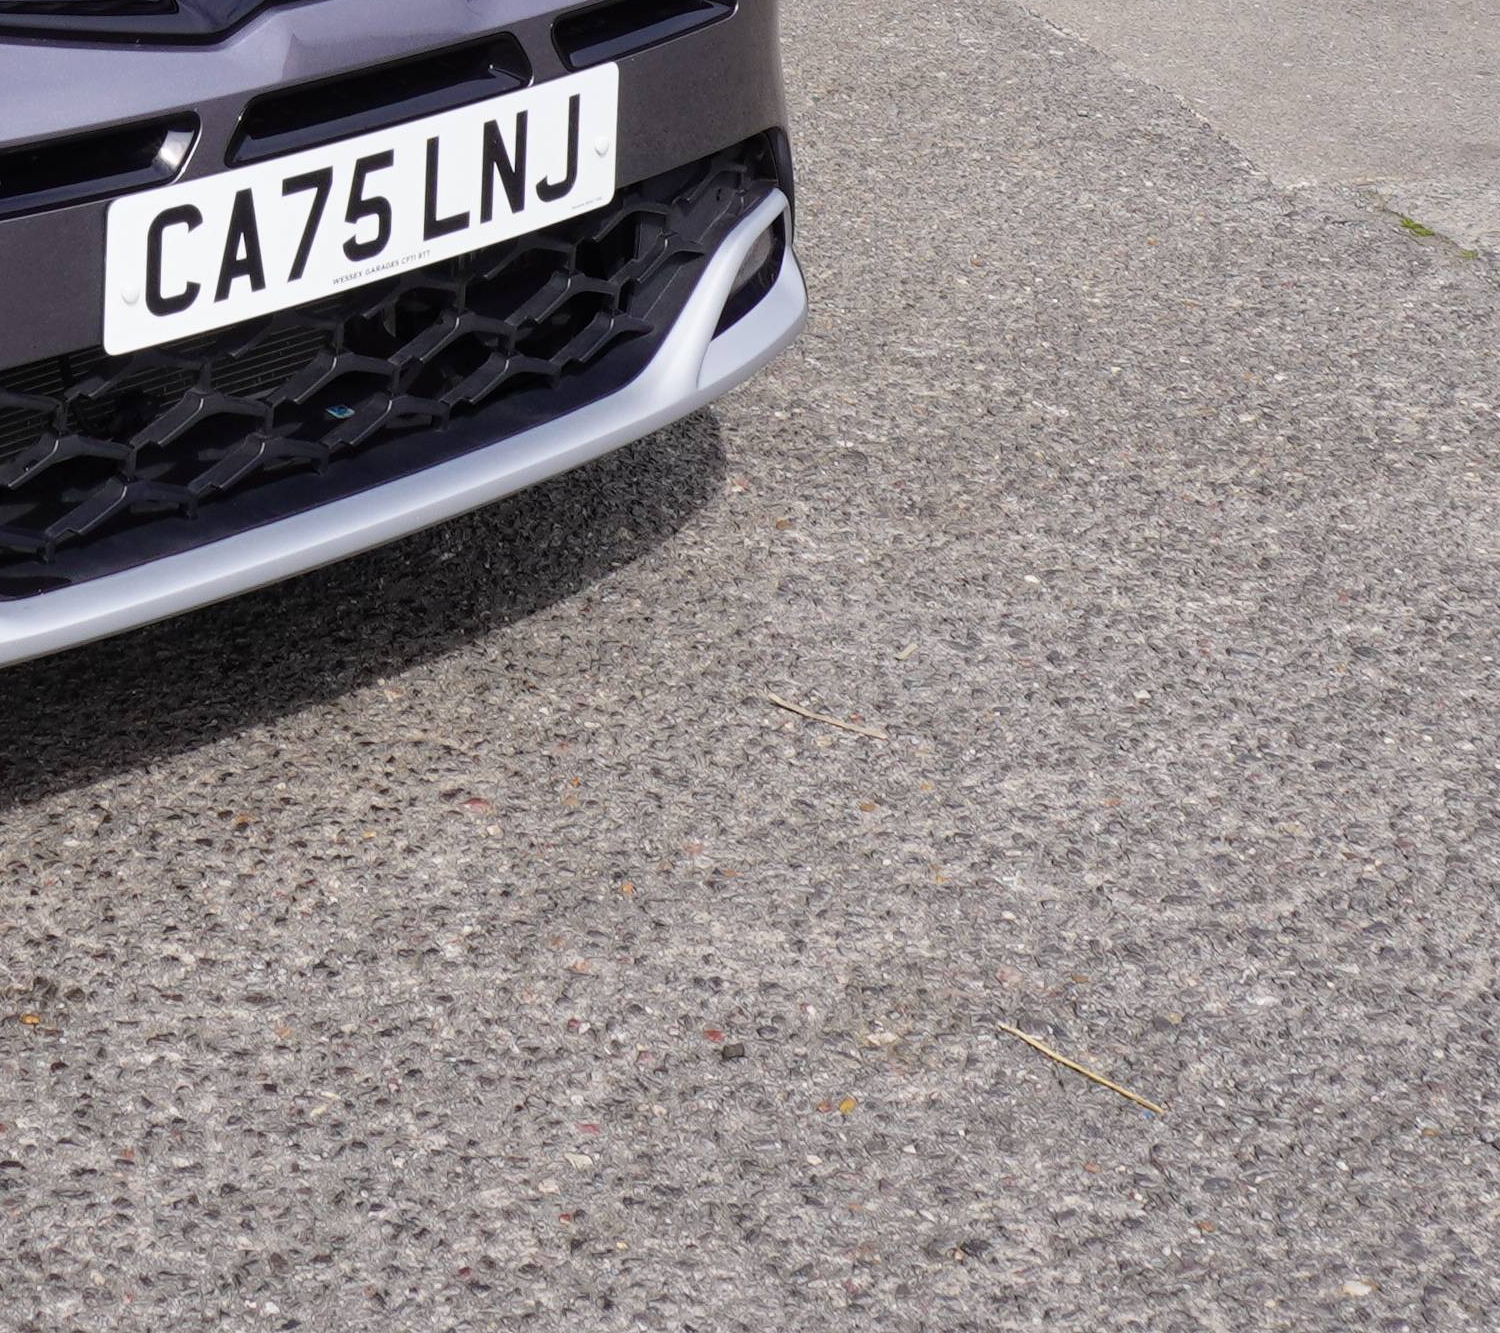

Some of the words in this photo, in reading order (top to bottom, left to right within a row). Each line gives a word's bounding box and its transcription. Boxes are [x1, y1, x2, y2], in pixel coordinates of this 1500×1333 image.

[144, 148, 396, 318] CA75
[422, 93, 581, 242] LNJ
[332, 270, 362, 285] WESSEX
[365, 258, 400, 276] GARAGES
